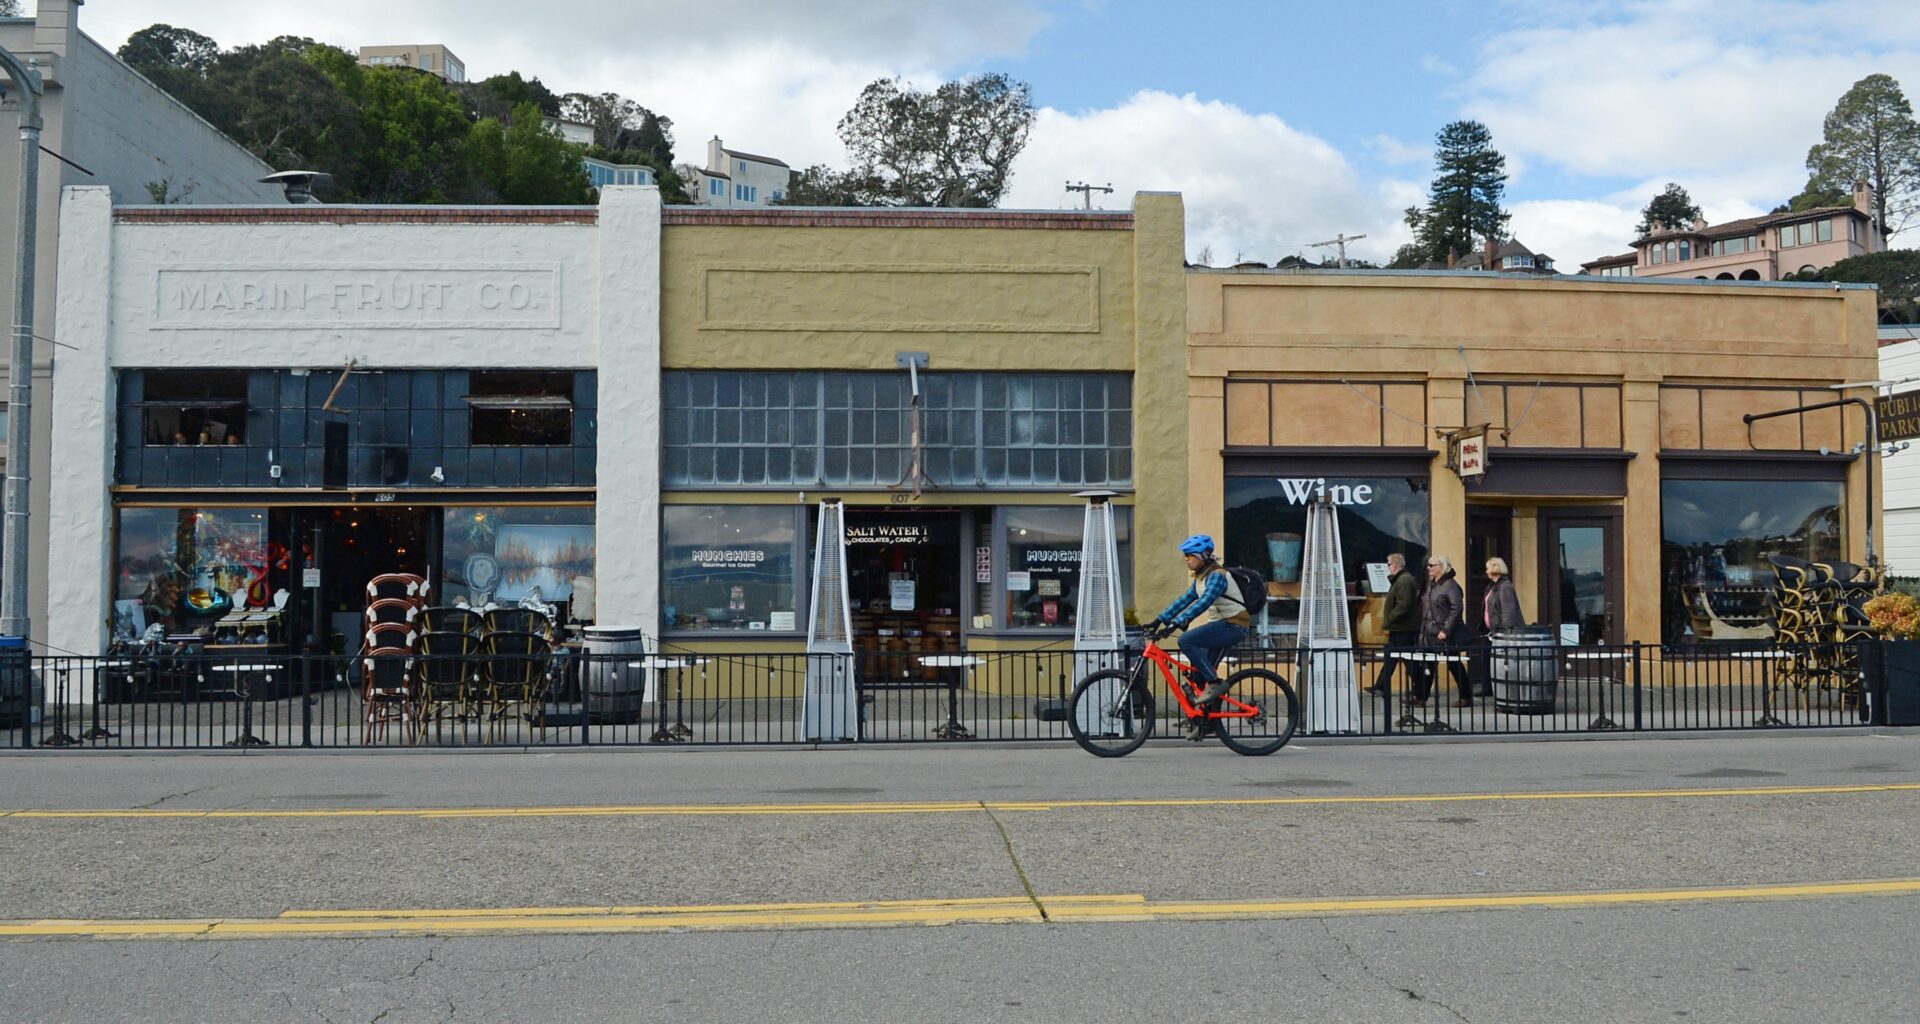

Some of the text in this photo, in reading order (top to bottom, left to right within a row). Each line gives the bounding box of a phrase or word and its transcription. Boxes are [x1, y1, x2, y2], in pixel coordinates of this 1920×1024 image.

[179, 283, 539, 310] MARIN FRUIT CO.
[1880, 396, 1920, 418] PUBLI
[1277, 478, 1373, 505] Wine
[891, 494, 909, 504] 607
[847, 526, 876, 537] SALT
[878, 525, 920, 536] WATER
[692, 550, 765, 562] MUNCHIES
[1026, 550, 1082, 562] MUNCHI
